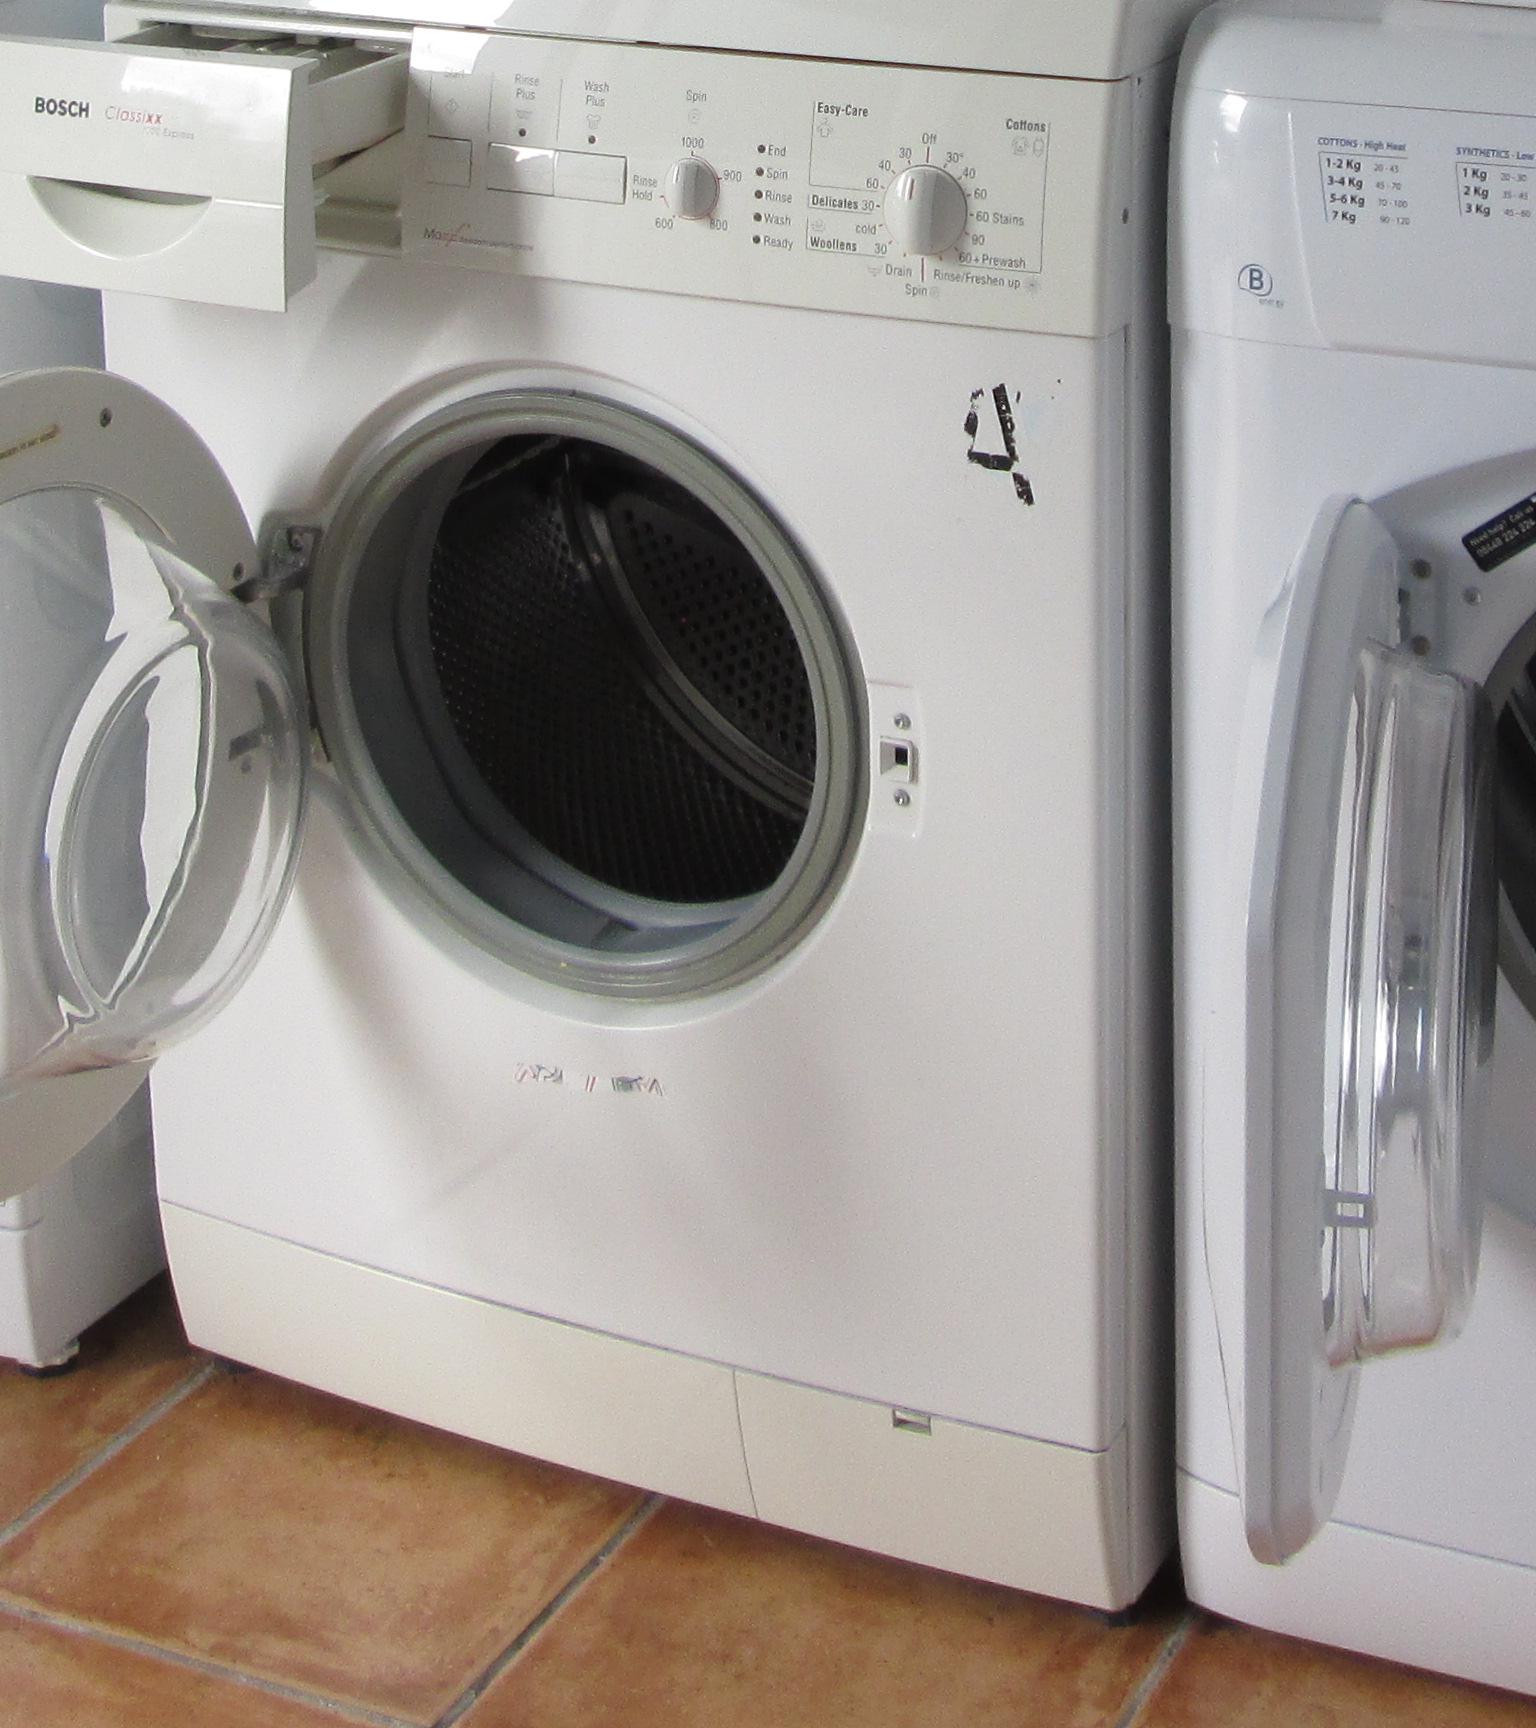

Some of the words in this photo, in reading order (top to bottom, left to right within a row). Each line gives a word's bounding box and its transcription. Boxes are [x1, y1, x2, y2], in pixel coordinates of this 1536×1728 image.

[515, 74, 540, 87] Rinse
[584, 80, 610, 93] Wash
[516, 88, 536, 100] Plus
[586, 94, 605, 107] Plus
[686, 90, 707, 103] Spin
[34, 97, 90, 119] BOSCH
[105, 105, 163, 125] Classixx
[817, 102, 869, 118] Easy-Care
[1006, 119, 1046, 133] Cottons
[681, 136, 704, 149] 1000
[922, 133, 937, 145] Off
[1317, 137, 1358, 148] COTTONS
[1364, 141, 1383, 151] High
[1386, 142, 1406, 151] Heat
[768, 144, 786, 157] End
[1456, 146, 1509, 158] SYNTHETICS
[1327, 158, 1343, 168] 1-2
[1346, 159, 1361, 172] Kg
[723, 170, 742, 183] 900
[766, 167, 789, 180] Spin
[962, 167, 976, 179] 40
[1463, 168, 1468, 177] 1
[1472, 168, 1487, 181] Kg
[633, 175, 658, 188] Rinse
[866, 178, 879, 189] 60
[1327, 175, 1345, 185] 3-4
[1348, 177, 1363, 190] Kg
[632, 189, 653, 201] Hold
[765, 190, 793, 203] Rinse
[973, 188, 987, 200] 60
[1463, 185, 1470, 195] 2
[1473, 186, 1489, 199] Kg
[812, 195, 858, 210] Delicates
[861, 200, 875, 212] 30
[1329, 193, 1347, 204] 5-6
[1350, 194, 1365, 208] Kg
[1465, 203, 1472, 213] 3
[1475, 204, 1491, 217] Kg
[655, 218, 673, 229] 600
[764, 213, 791, 226] Wash
[975, 211, 989, 223] 60
[992, 212, 1025, 226] Stains
[1332, 211, 1338, 221] 7
[1341, 211, 1356, 224] Kg
[710, 219, 728, 231] 800
[855, 223, 877, 235] cold
[764, 235, 793, 251] Ready
[810, 236, 857, 252] Woollens
[874, 244, 888, 256] 30
[959, 253, 972, 265] 60
[981, 254, 1026, 269] Prewash
[885, 264, 912, 277] Drain
[933, 269, 1004, 287] Rinse/Freshen
[1007, 278, 1021, 289] up
[1249, 268, 1264, 290] B
[905, 284, 927, 297] Spin
